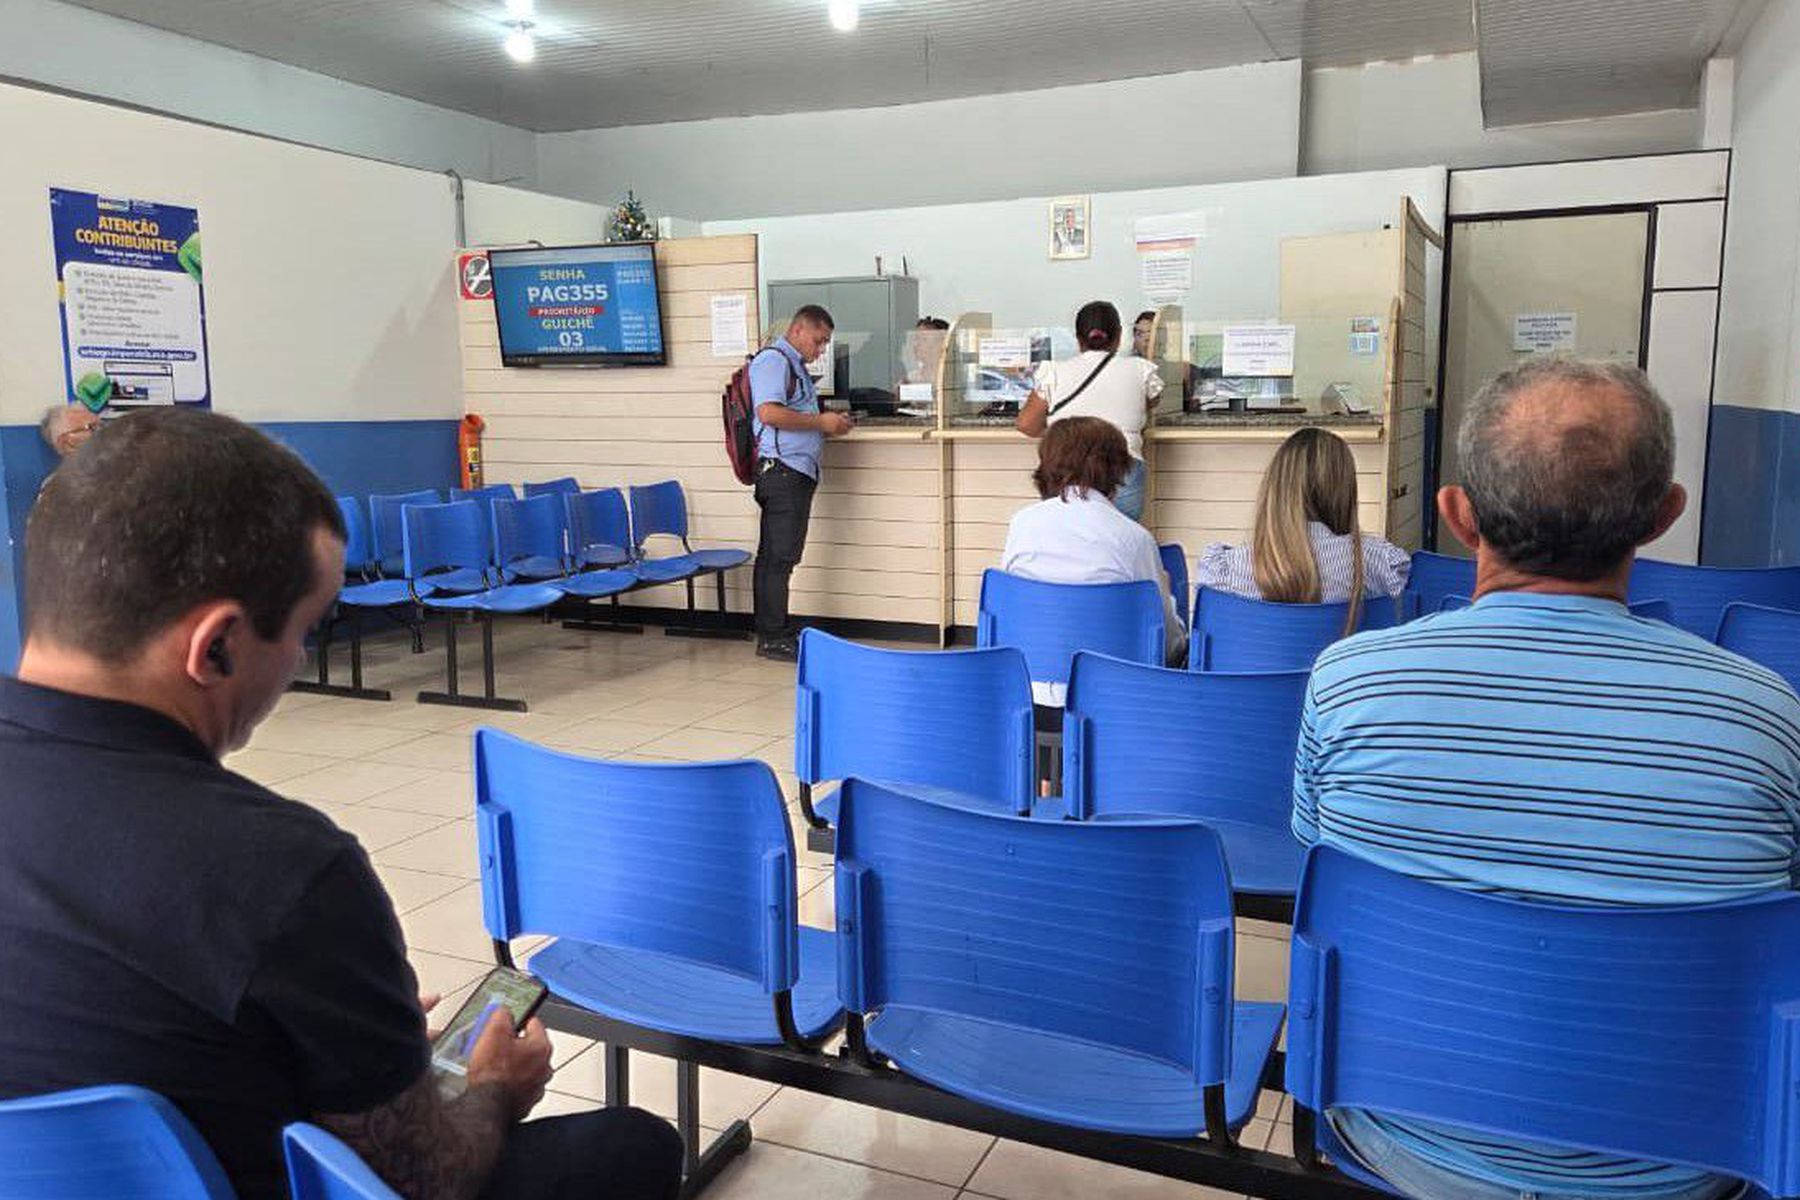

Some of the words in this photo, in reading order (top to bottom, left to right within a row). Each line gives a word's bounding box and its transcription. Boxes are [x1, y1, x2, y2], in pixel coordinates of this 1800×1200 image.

[98, 215, 159, 236] ATENÇÃO
[75, 228, 177, 254] CONTRIBUINTES
[540, 269, 586, 281] SENHA
[527, 284, 609, 303] PAG355
[559, 331, 584, 348] 03
